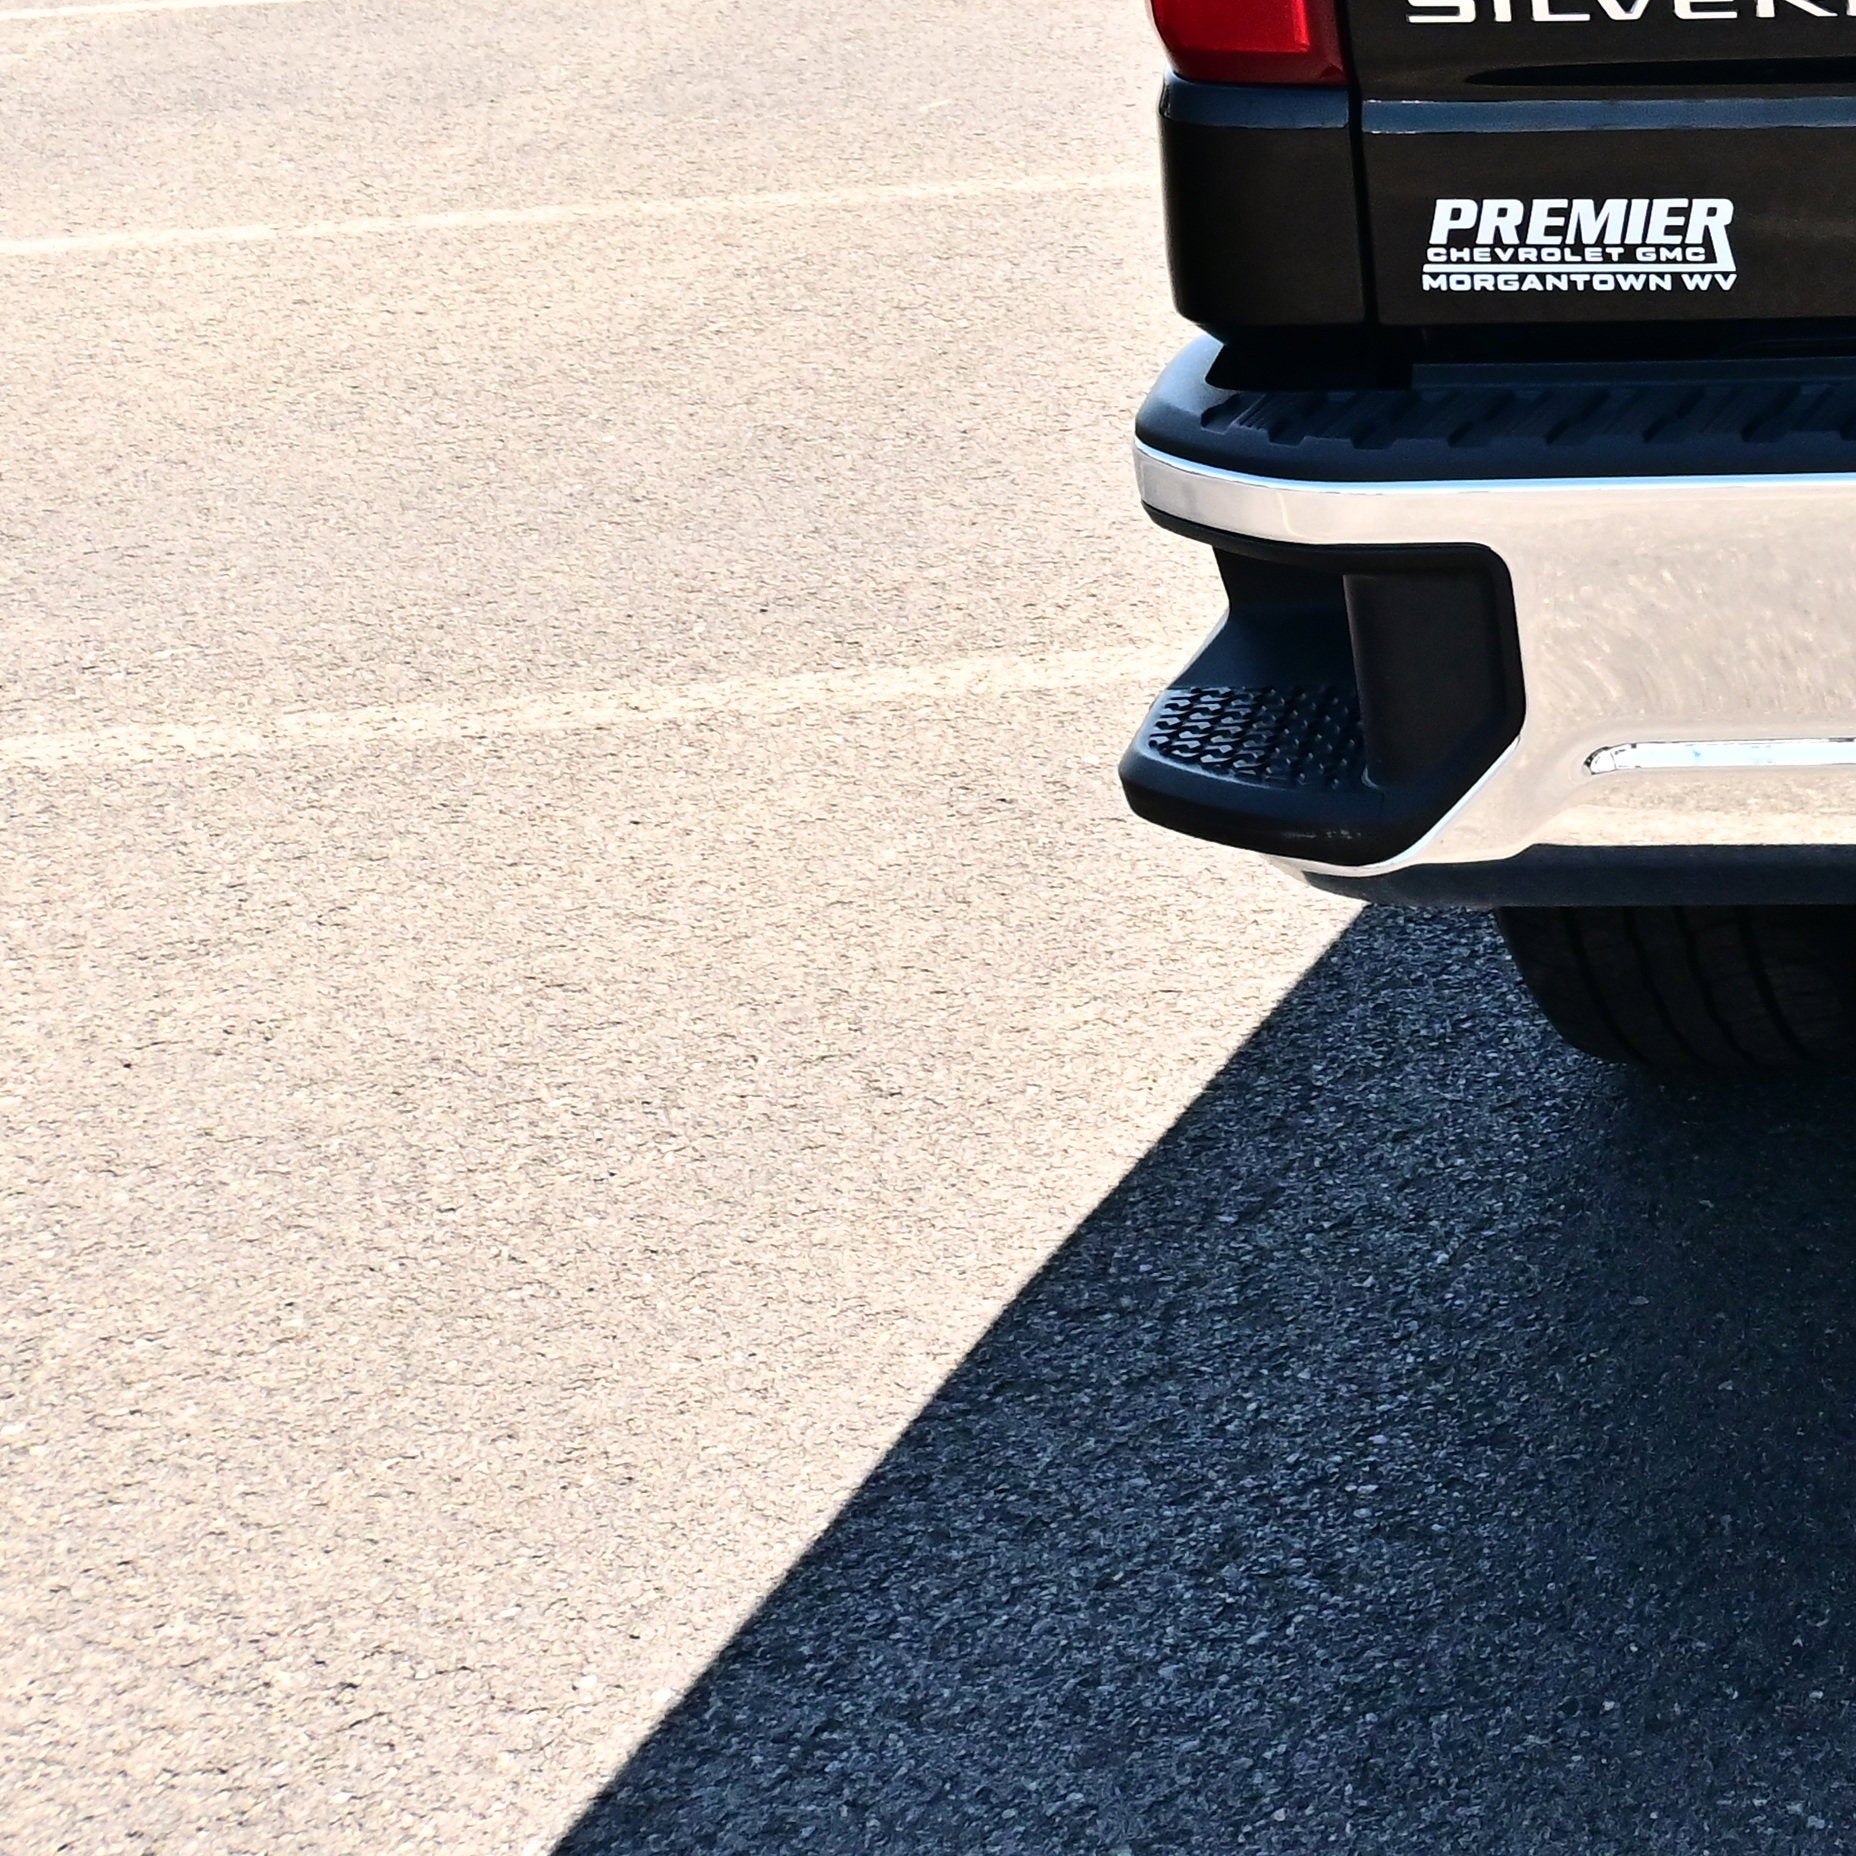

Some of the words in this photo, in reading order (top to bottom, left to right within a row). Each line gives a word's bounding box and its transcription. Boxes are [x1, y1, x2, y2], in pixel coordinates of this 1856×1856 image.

[1428, 197, 1736, 271] PREMIER
[1426, 246, 1626, 263] CHEVROLET
[1635, 246, 1707, 263] GMC
[1422, 273, 1673, 292] MORGANTOWN
[1681, 273, 1738, 291] WV
